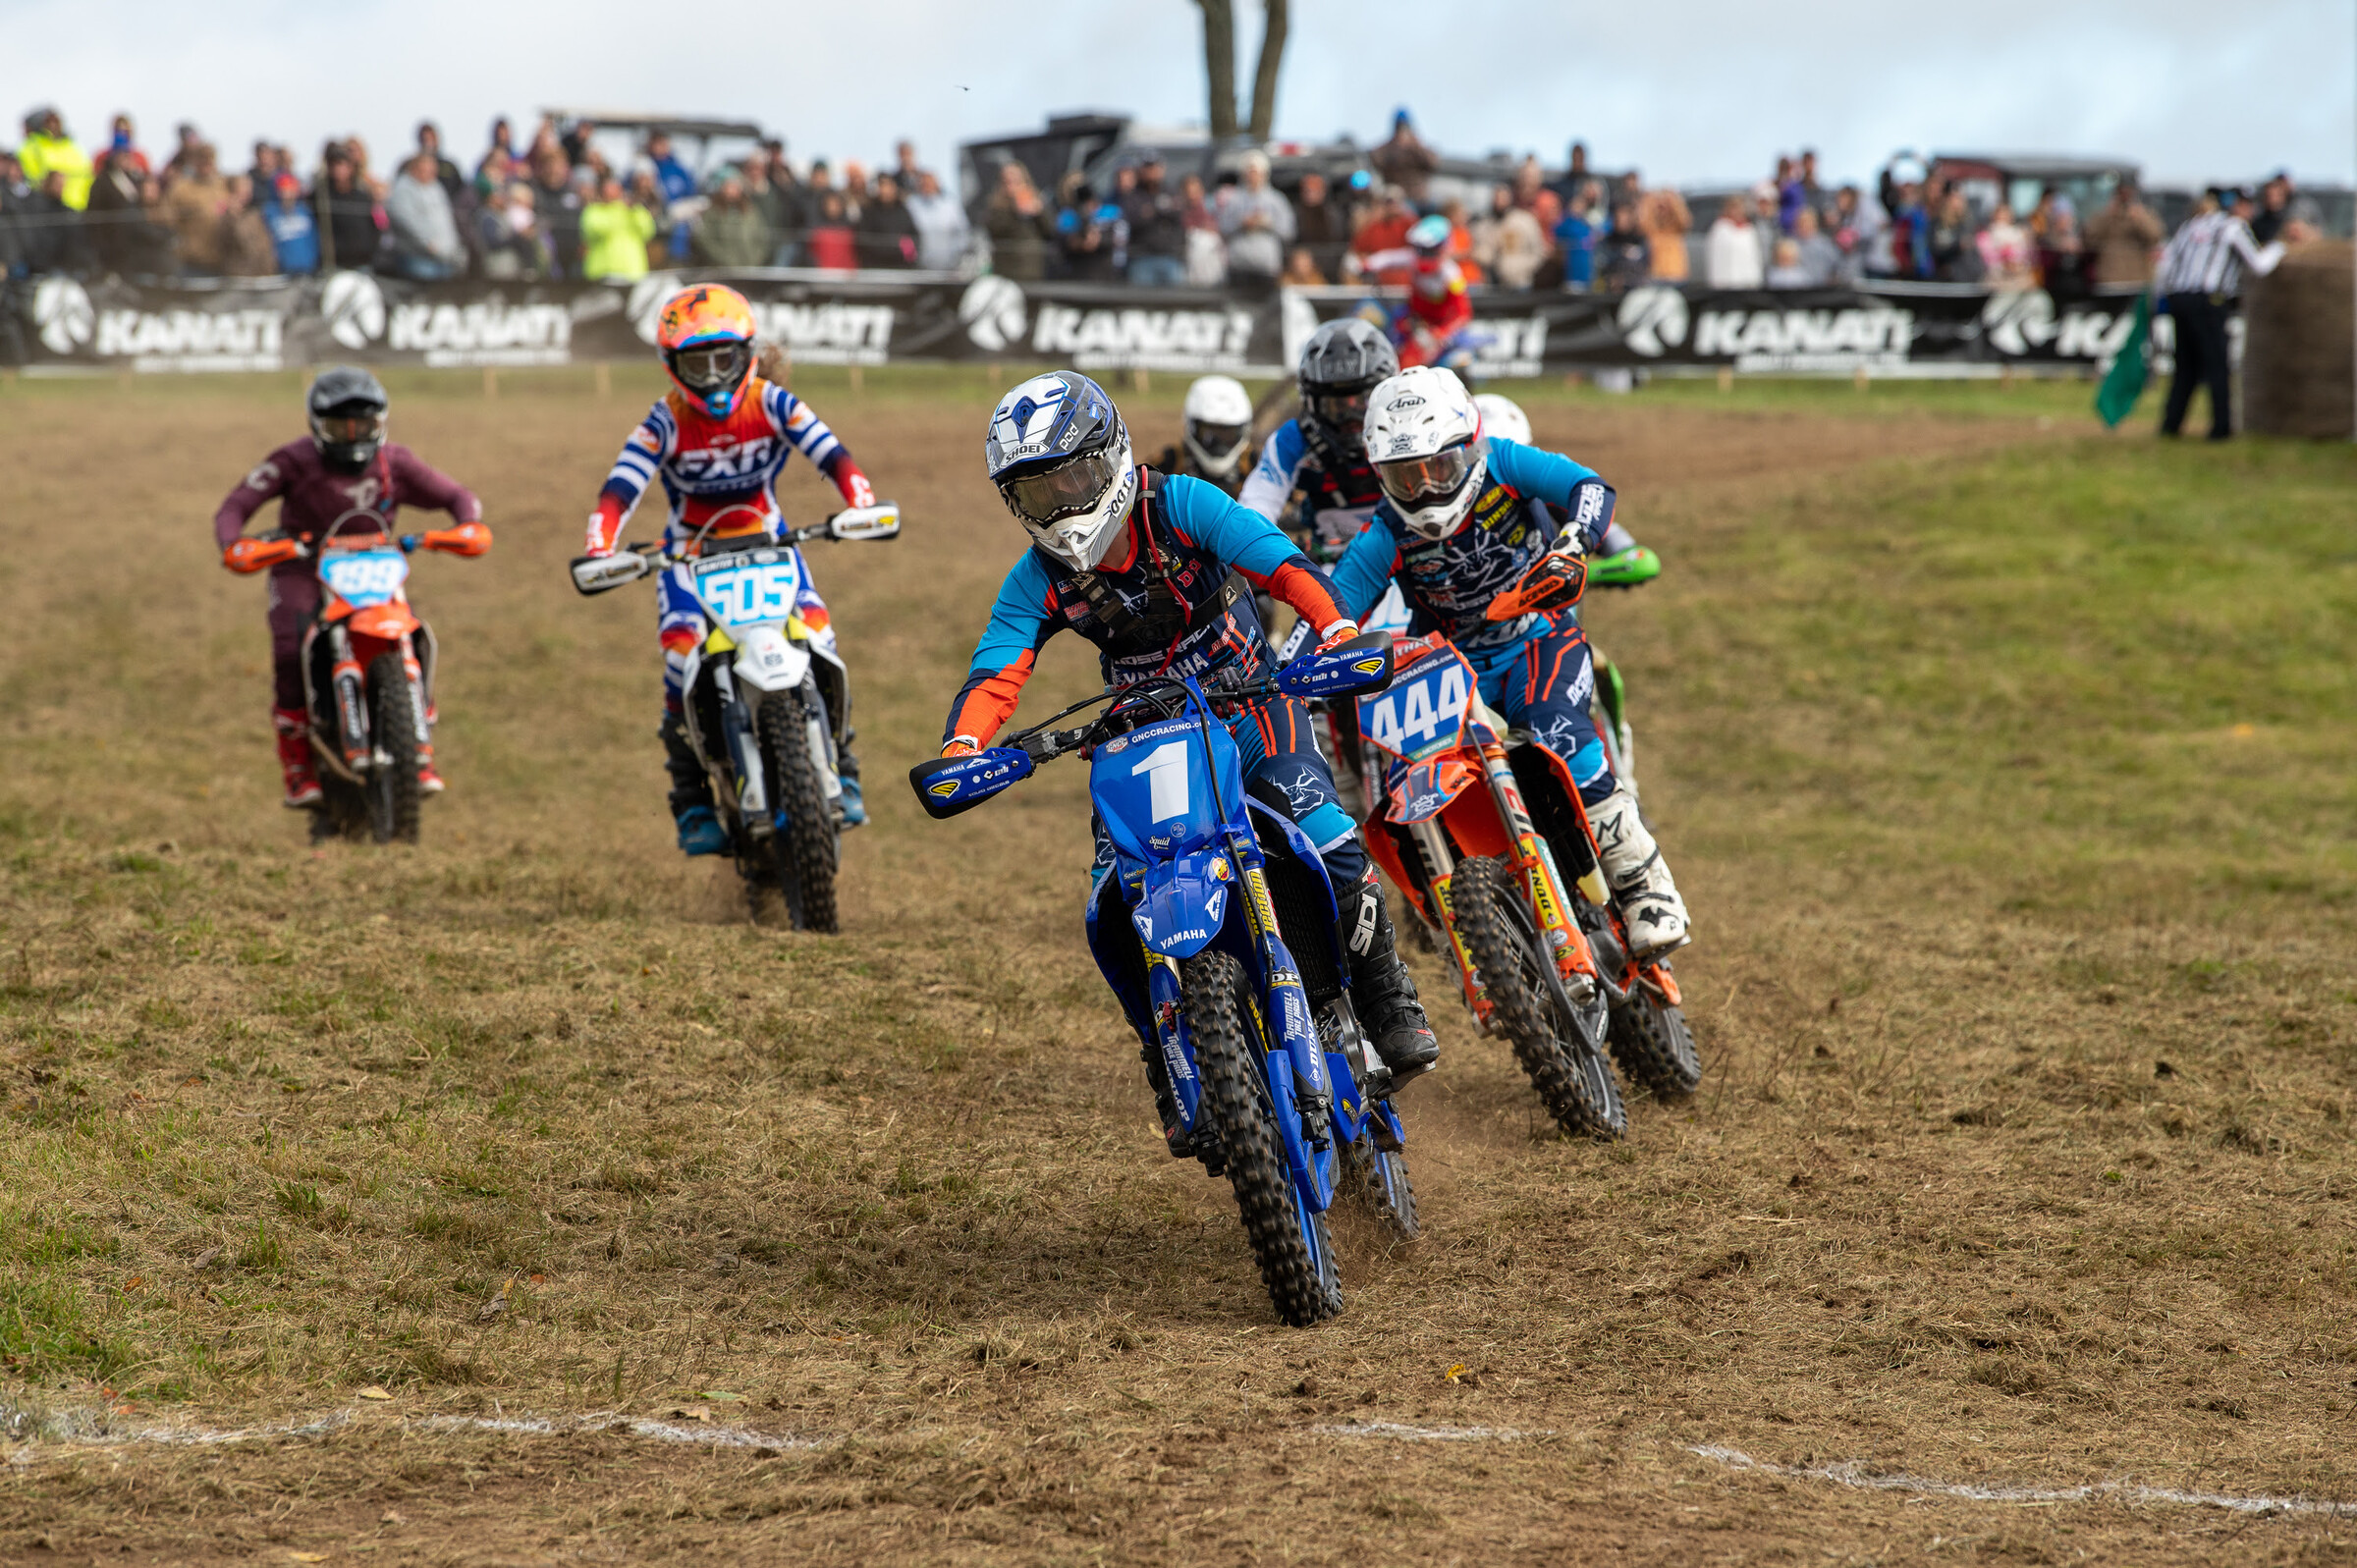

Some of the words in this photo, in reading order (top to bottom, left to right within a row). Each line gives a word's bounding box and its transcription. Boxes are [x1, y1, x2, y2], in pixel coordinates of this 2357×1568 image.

[96, 309, 283, 355] KANATI
[389, 303, 573, 351] KANATI
[1032, 302, 1254, 352] KANATI
[1694, 307, 1914, 356] KANATI
[1390, 395, 1424, 409] Arai
[675, 435, 773, 479] FXR
[1006, 444, 1040, 464] SHOEI
[704, 565, 795, 626] 505
[1339, 650, 1364, 662] YAMAHA
[1371, 663, 1469, 759] 444
[941, 764, 965, 776] YAMAHA
[1131, 739, 1189, 825] 1
[1160, 928, 1208, 949] YAMAHA
[1349, 892, 1378, 956] SIDI
